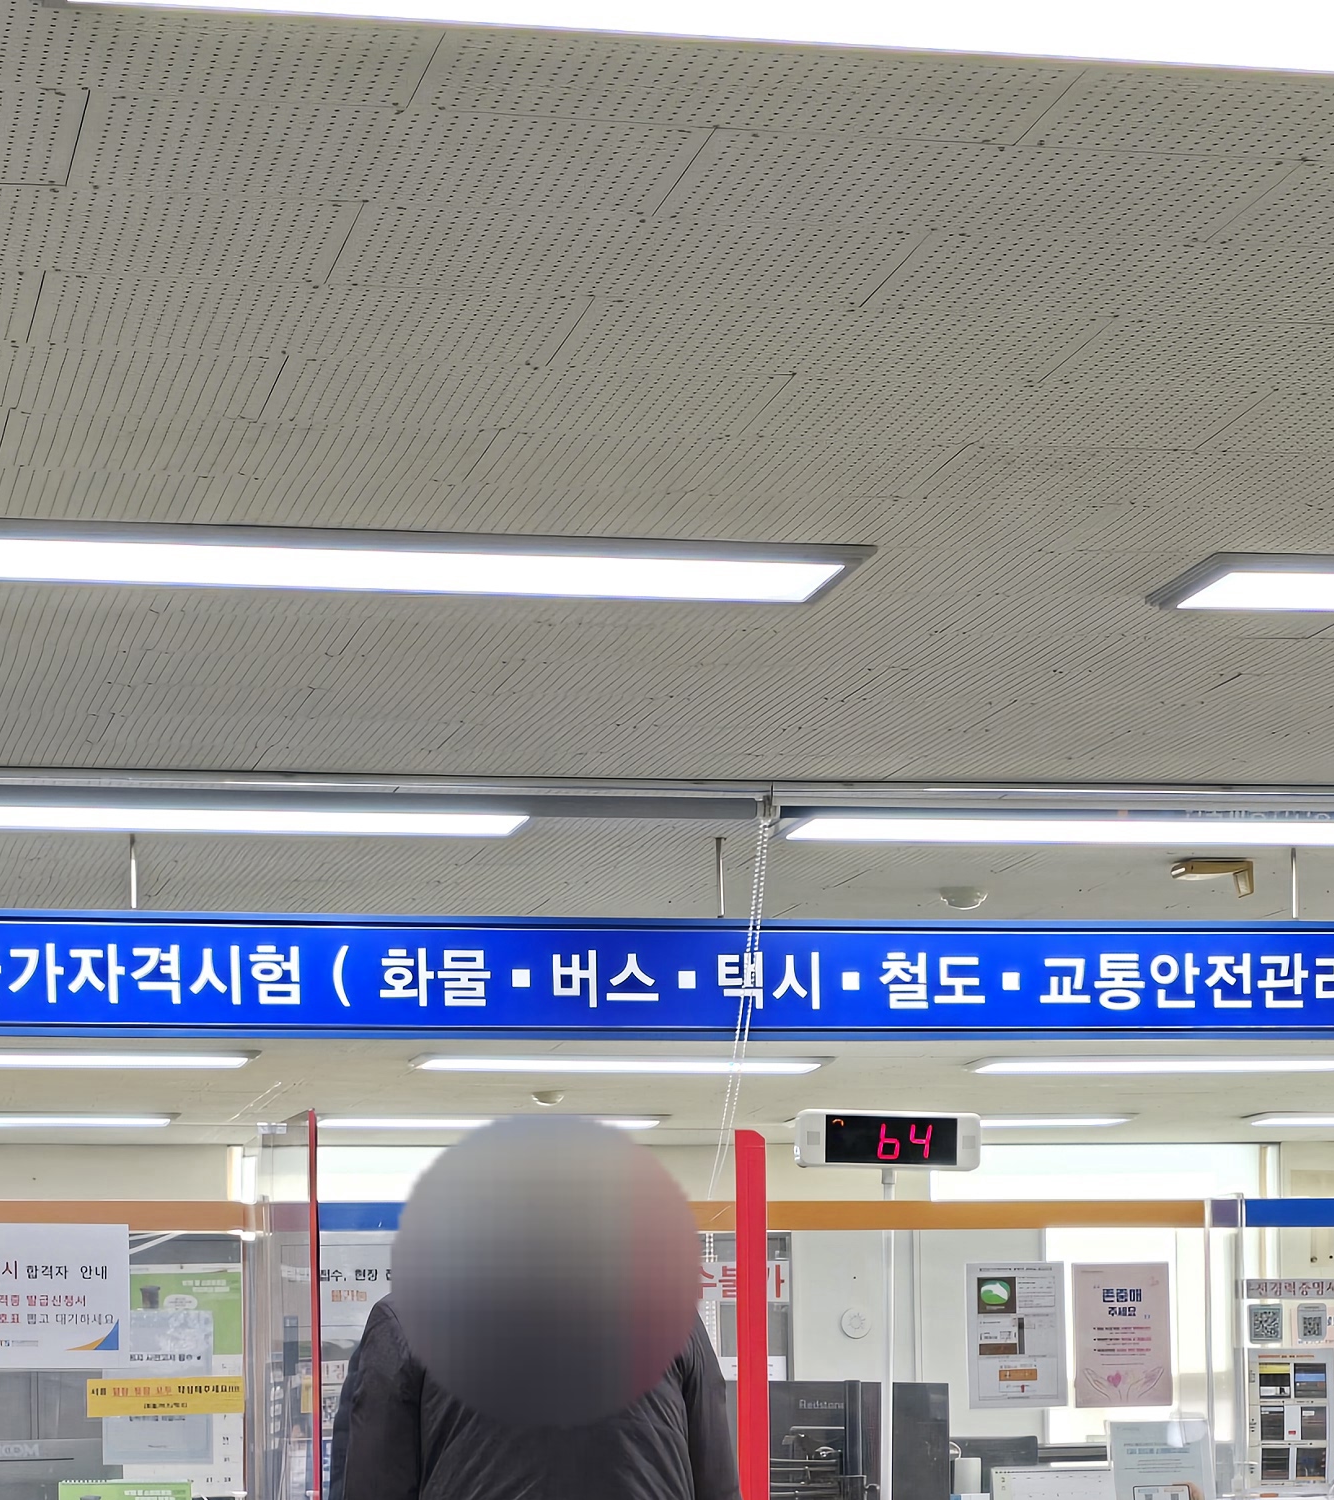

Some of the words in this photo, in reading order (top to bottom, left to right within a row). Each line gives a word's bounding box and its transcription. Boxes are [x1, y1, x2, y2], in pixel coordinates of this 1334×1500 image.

[379, 947, 492, 1008] 화물
[552, 949, 660, 1009] 버스
[717, 951, 822, 1010] 택시
[878, 951, 987, 1010] 철도
[876, 1123, 934, 1160] 64
[79, 1264, 109, 1280] 안내
